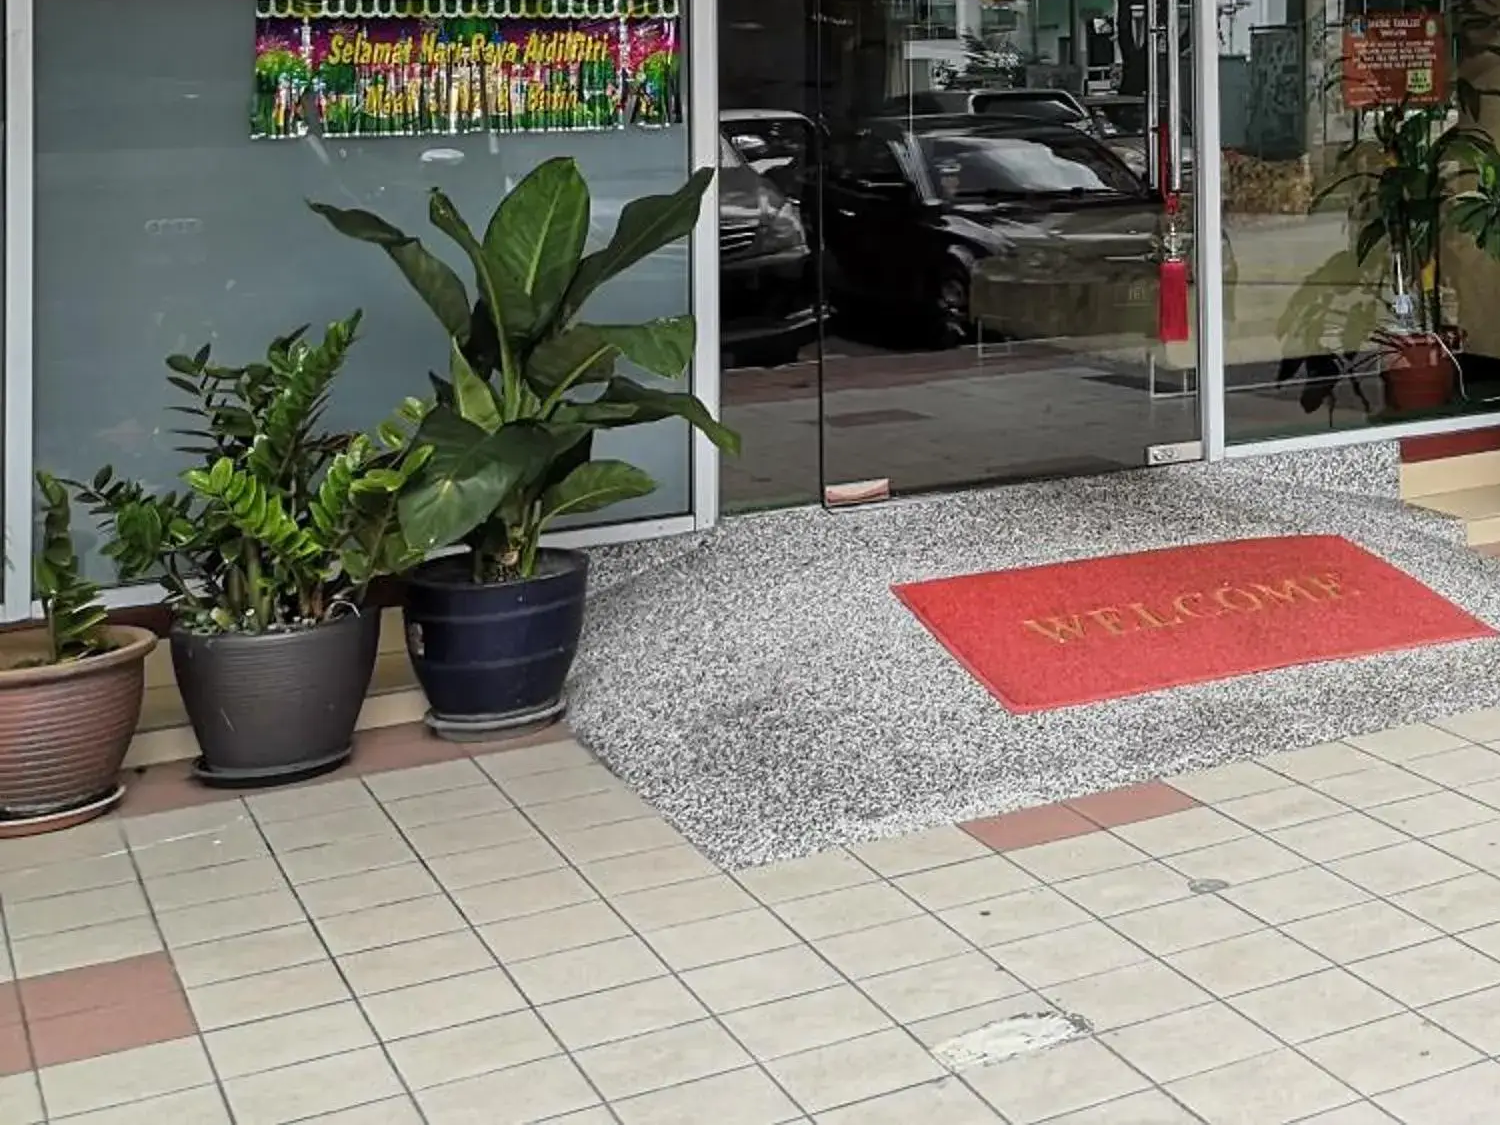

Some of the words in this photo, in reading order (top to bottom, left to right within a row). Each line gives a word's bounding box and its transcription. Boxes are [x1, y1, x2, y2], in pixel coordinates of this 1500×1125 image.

[328, 32, 412, 65] Selamat
[421, 30, 463, 65] Hari
[471, 33, 517, 71] Raya
[1024, 574, 1344, 643] WELCOME
